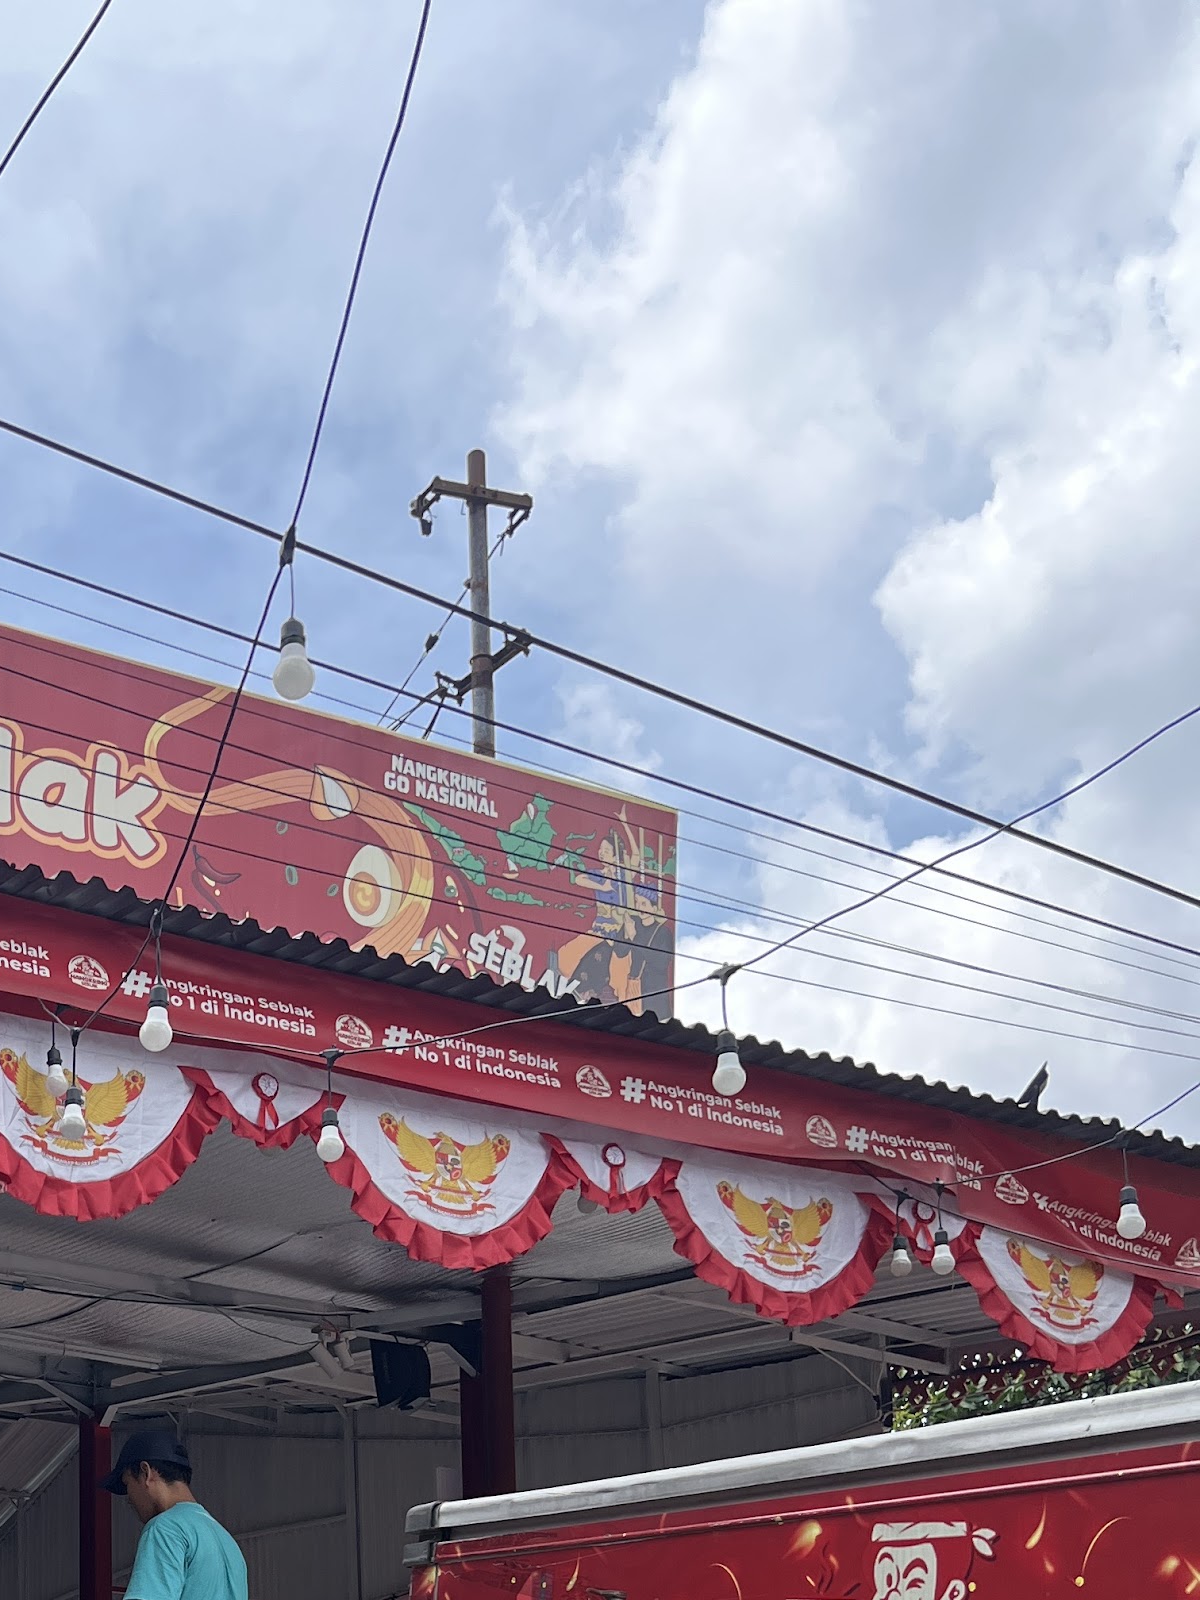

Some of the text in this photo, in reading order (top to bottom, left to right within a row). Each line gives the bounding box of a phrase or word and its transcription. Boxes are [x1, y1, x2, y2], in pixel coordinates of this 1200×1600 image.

[384, 771, 498, 819] GO NASIONAL
[391, 753, 487, 796] NANGKRING
[164, 990, 316, 1037] o 1 di Indonesia
[258, 997, 315, 1020] Seblak
[414, 1029, 505, 1061] Angkringan
[509, 1048, 559, 1073] Seblak
[414, 1045, 561, 1088] No 1 di Indonesia
[648, 1080, 732, 1108] Angkringan
[735, 1098, 782, 1120] Seblak
[650, 1095, 784, 1136] No 1 di Indonesia
[870, 1129, 952, 1152] Angkringan
[955, 1153, 985, 1175] blak
[871, 1144, 897, 1159] No
[899, 1149, 908, 1161] 1
[911, 1150, 927, 1162] di
[1049, 1200, 1120, 1230] Angkringa
[1080, 1224, 1093, 1239] di
[1094, 1229, 1162, 1262] Indonesia
